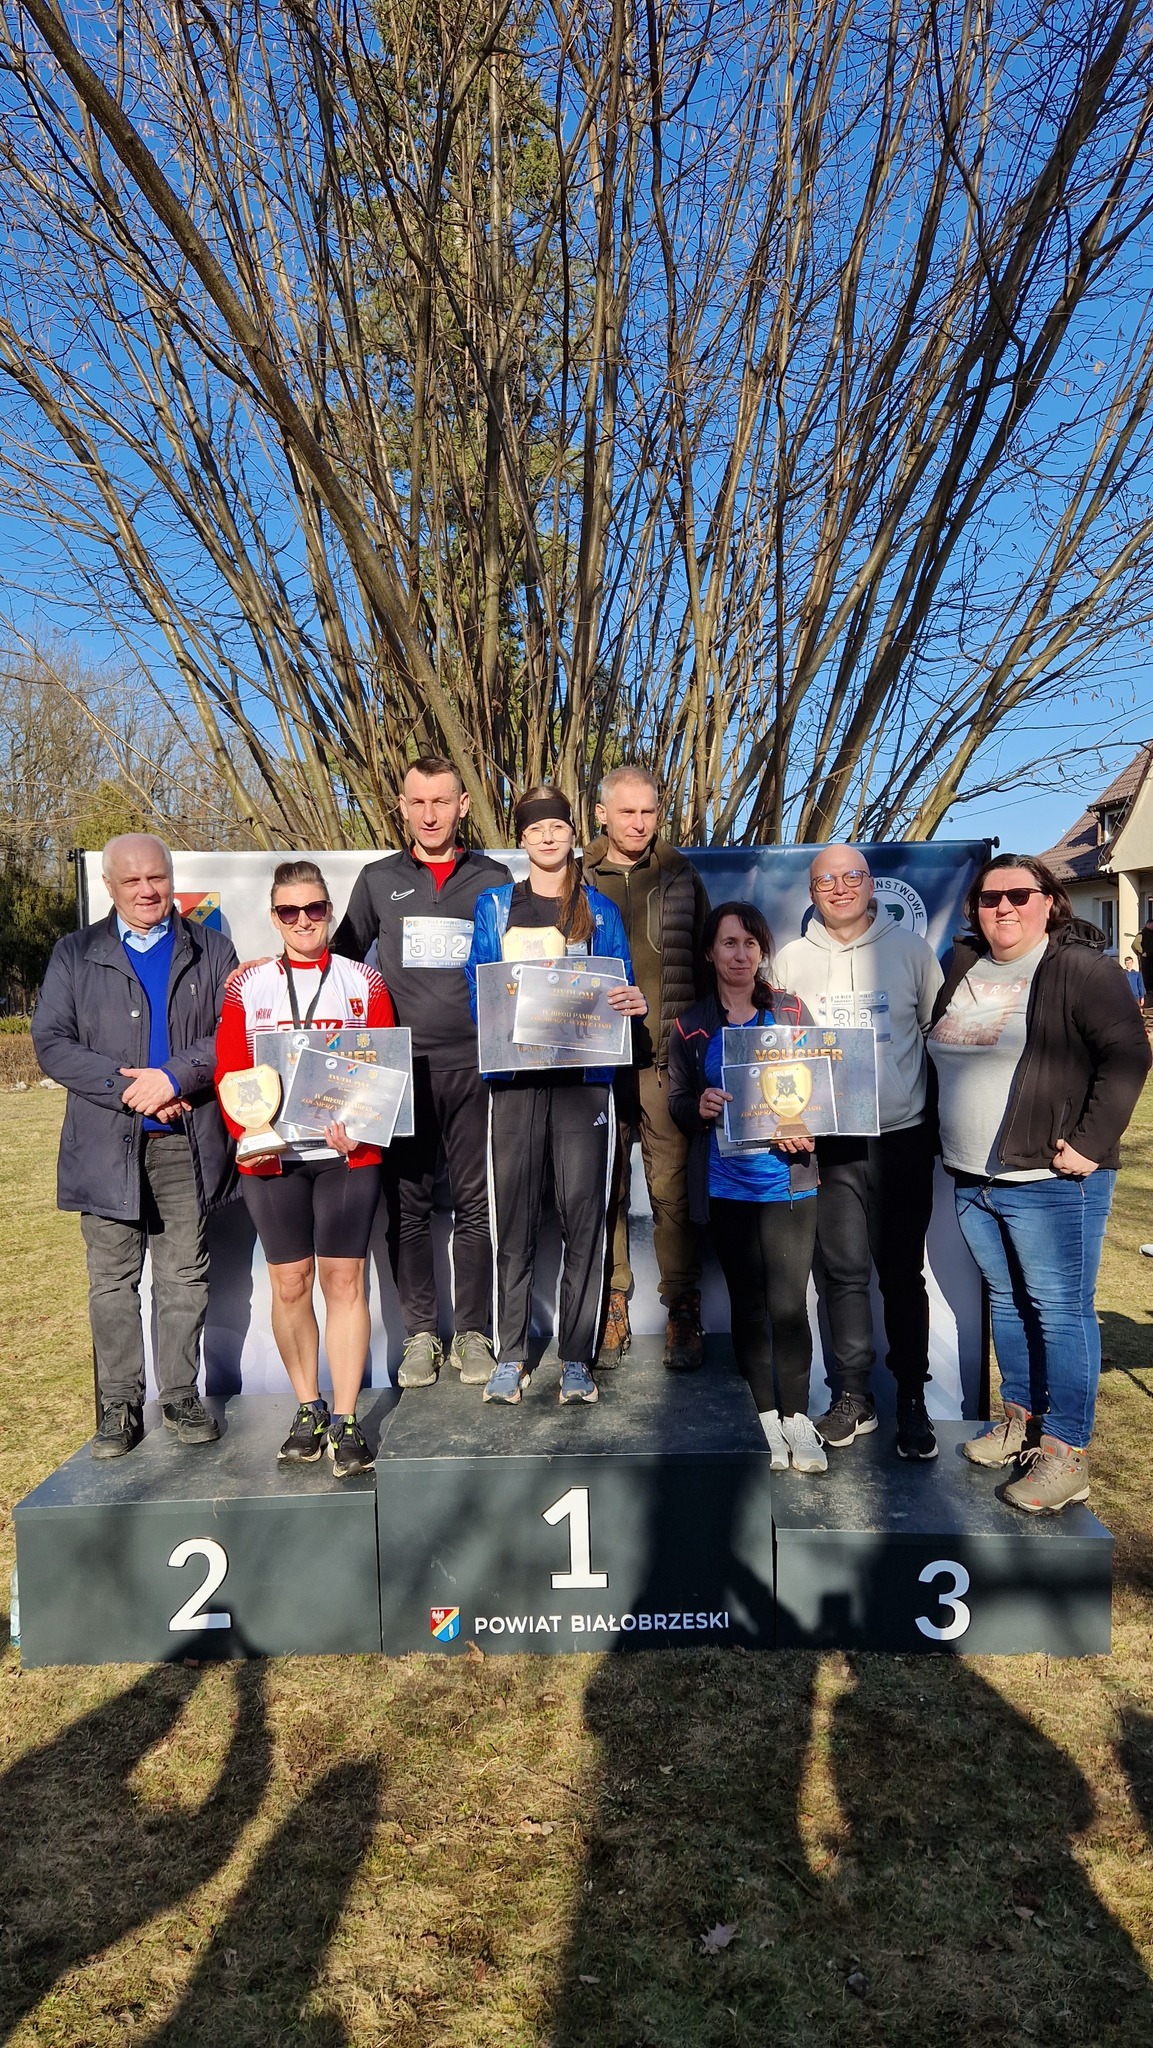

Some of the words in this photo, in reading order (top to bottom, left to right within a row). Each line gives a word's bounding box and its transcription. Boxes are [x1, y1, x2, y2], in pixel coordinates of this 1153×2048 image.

[874, 879, 924, 919] ŃSTWOWE
[410, 934, 467, 959] 532
[755, 1048, 844, 1062] VOUCHER
[541, 1486, 609, 1589] 1
[167, 1537, 232, 1632] 2
[915, 1560, 970, 1640] 3
[474, 1615, 562, 1634] POWIAT
[571, 1611, 730, 1633] BIAŁOBRZESKI
